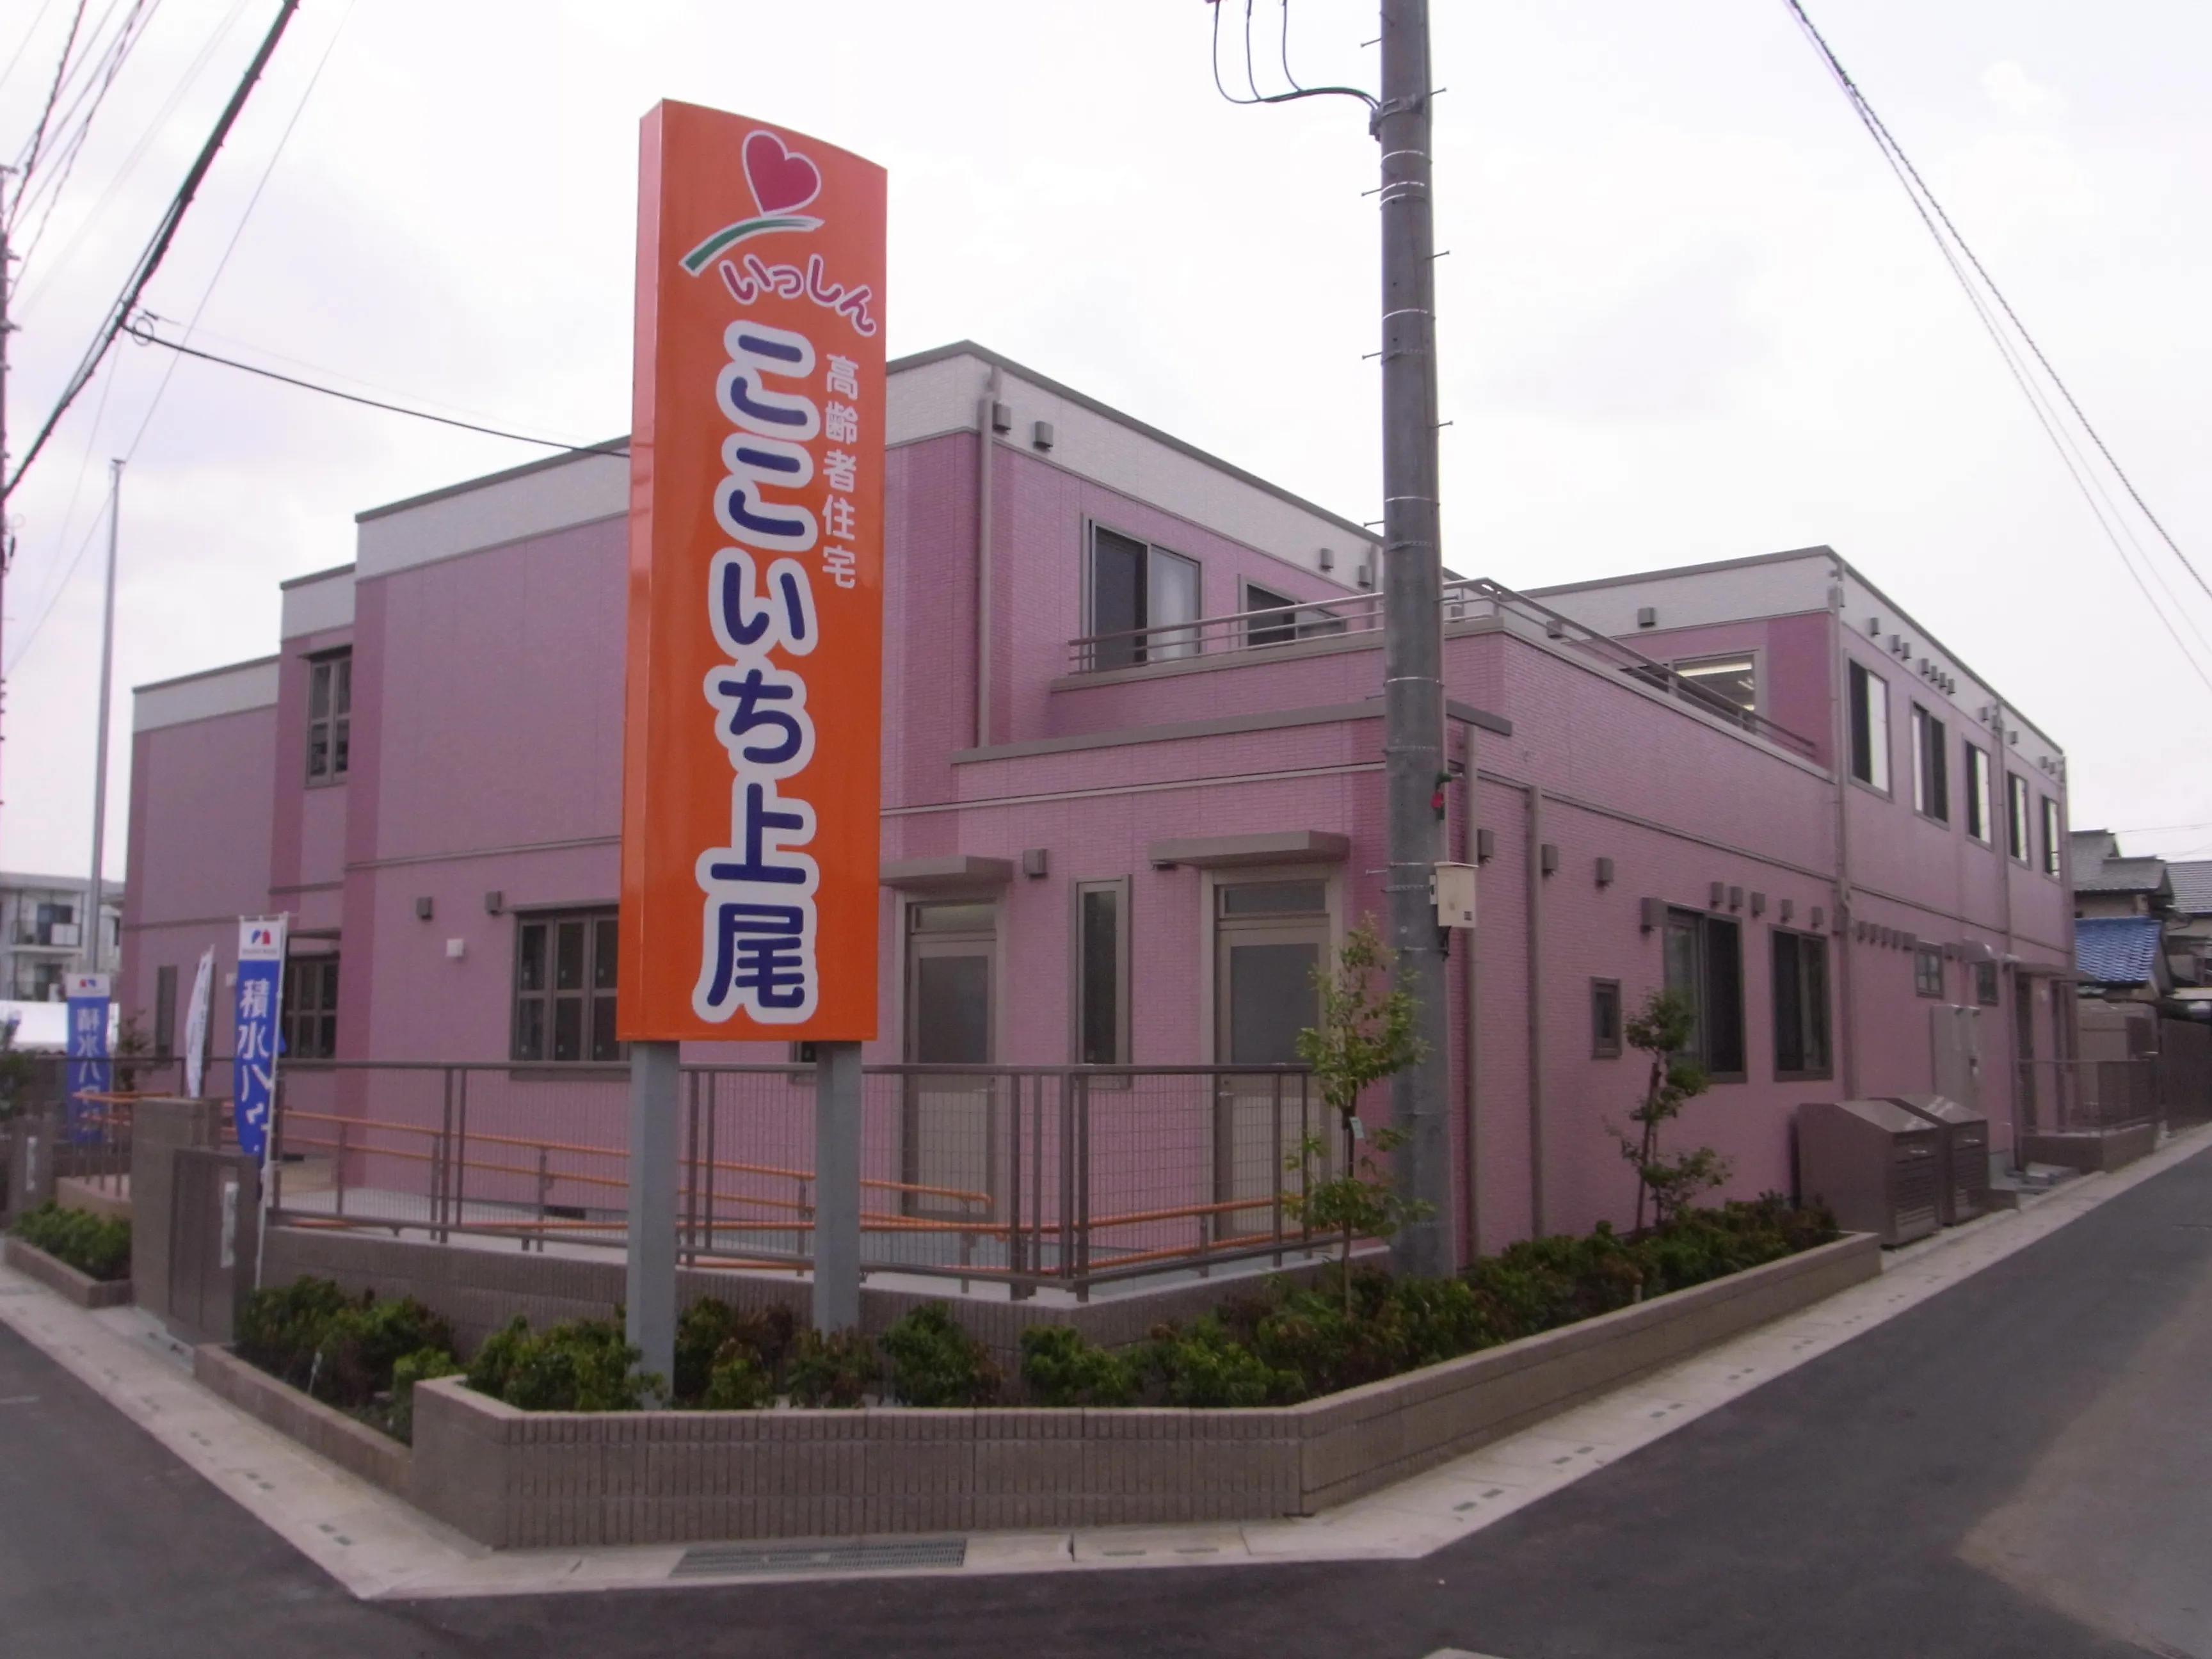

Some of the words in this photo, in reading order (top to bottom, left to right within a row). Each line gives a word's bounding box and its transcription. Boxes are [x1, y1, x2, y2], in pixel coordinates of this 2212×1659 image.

[719, 254, 877, 337] いっしん
[822, 353, 860, 589] 高齢者住宅
[692, 320, 821, 1023] ここいち上尾
[237, 978, 274, 1152] 積水ハ
